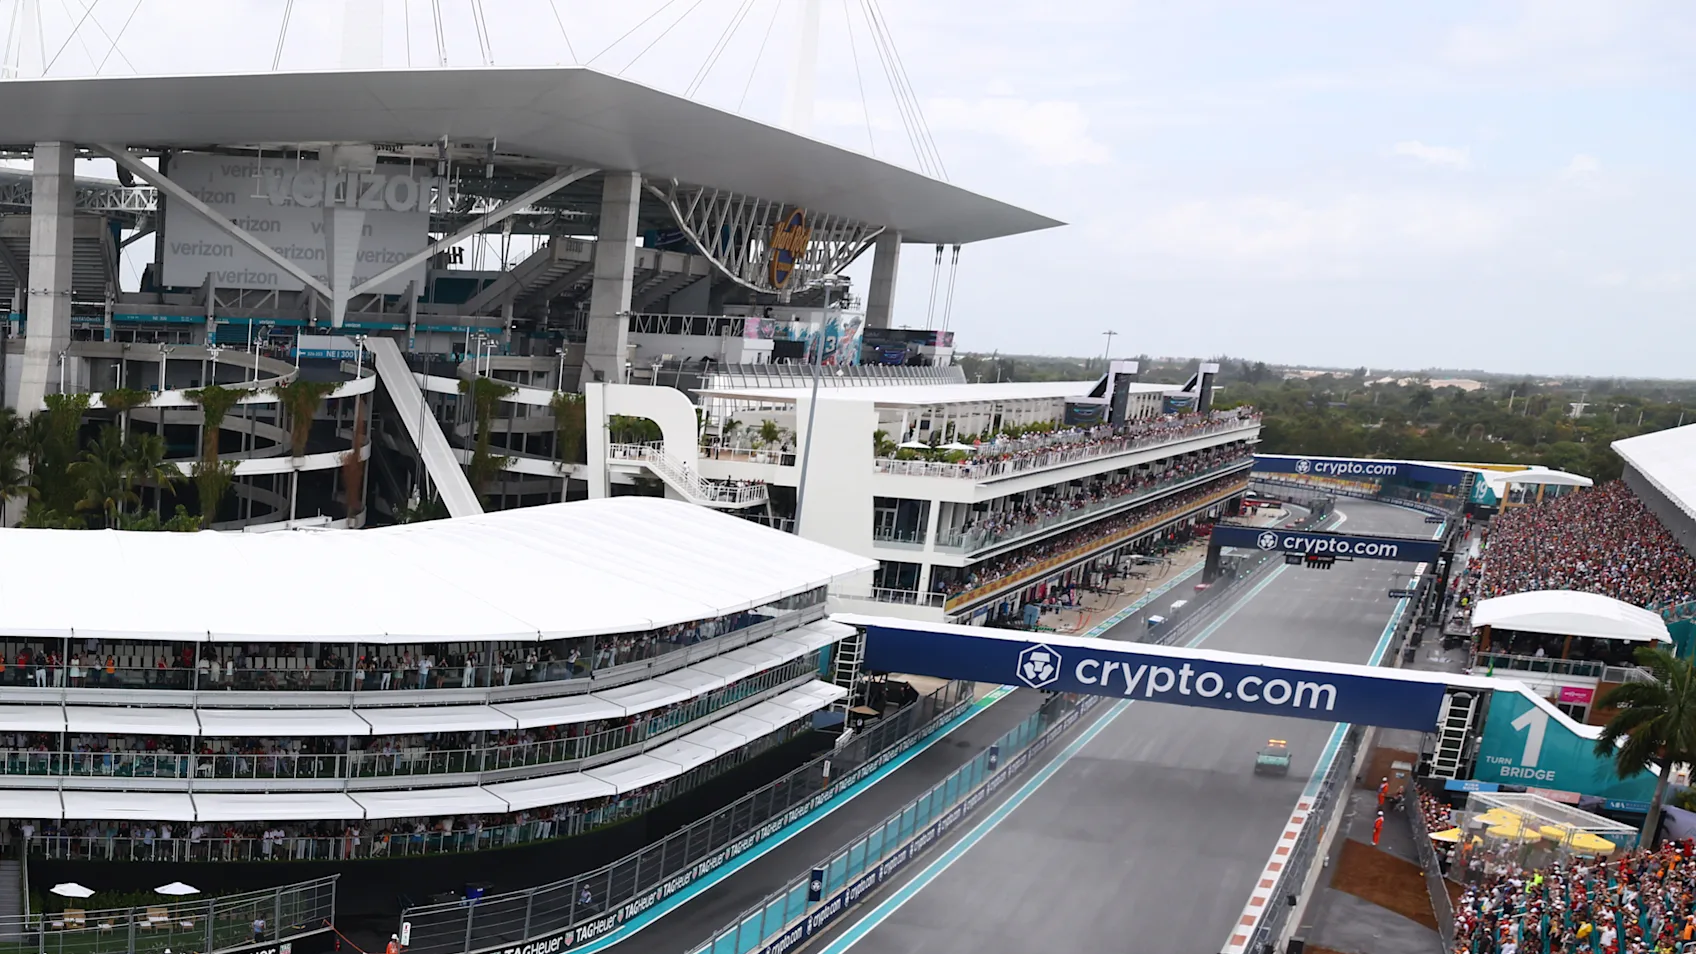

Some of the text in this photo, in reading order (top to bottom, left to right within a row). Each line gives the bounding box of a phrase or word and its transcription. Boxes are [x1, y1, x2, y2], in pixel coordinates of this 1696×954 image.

[265, 168, 451, 213] verizon
[170, 240, 234, 257] verizon
[217, 268, 278, 285] verizon
[1315, 460, 1397, 476] crypto.com
[1474, 480, 1489, 499] 19
[1283, 535, 1398, 558] crypto.com
[1075, 654, 1338, 711] crypto.com
[1510, 705, 1549, 768] 1
[1485, 755, 1513, 766] TURN
[1499, 766, 1556, 782] BRIDGE
[850, 874, 876, 900] crypto.com
[812, 898, 842, 929] crypto.com
[575, 914, 617, 942] TAGHeuer
